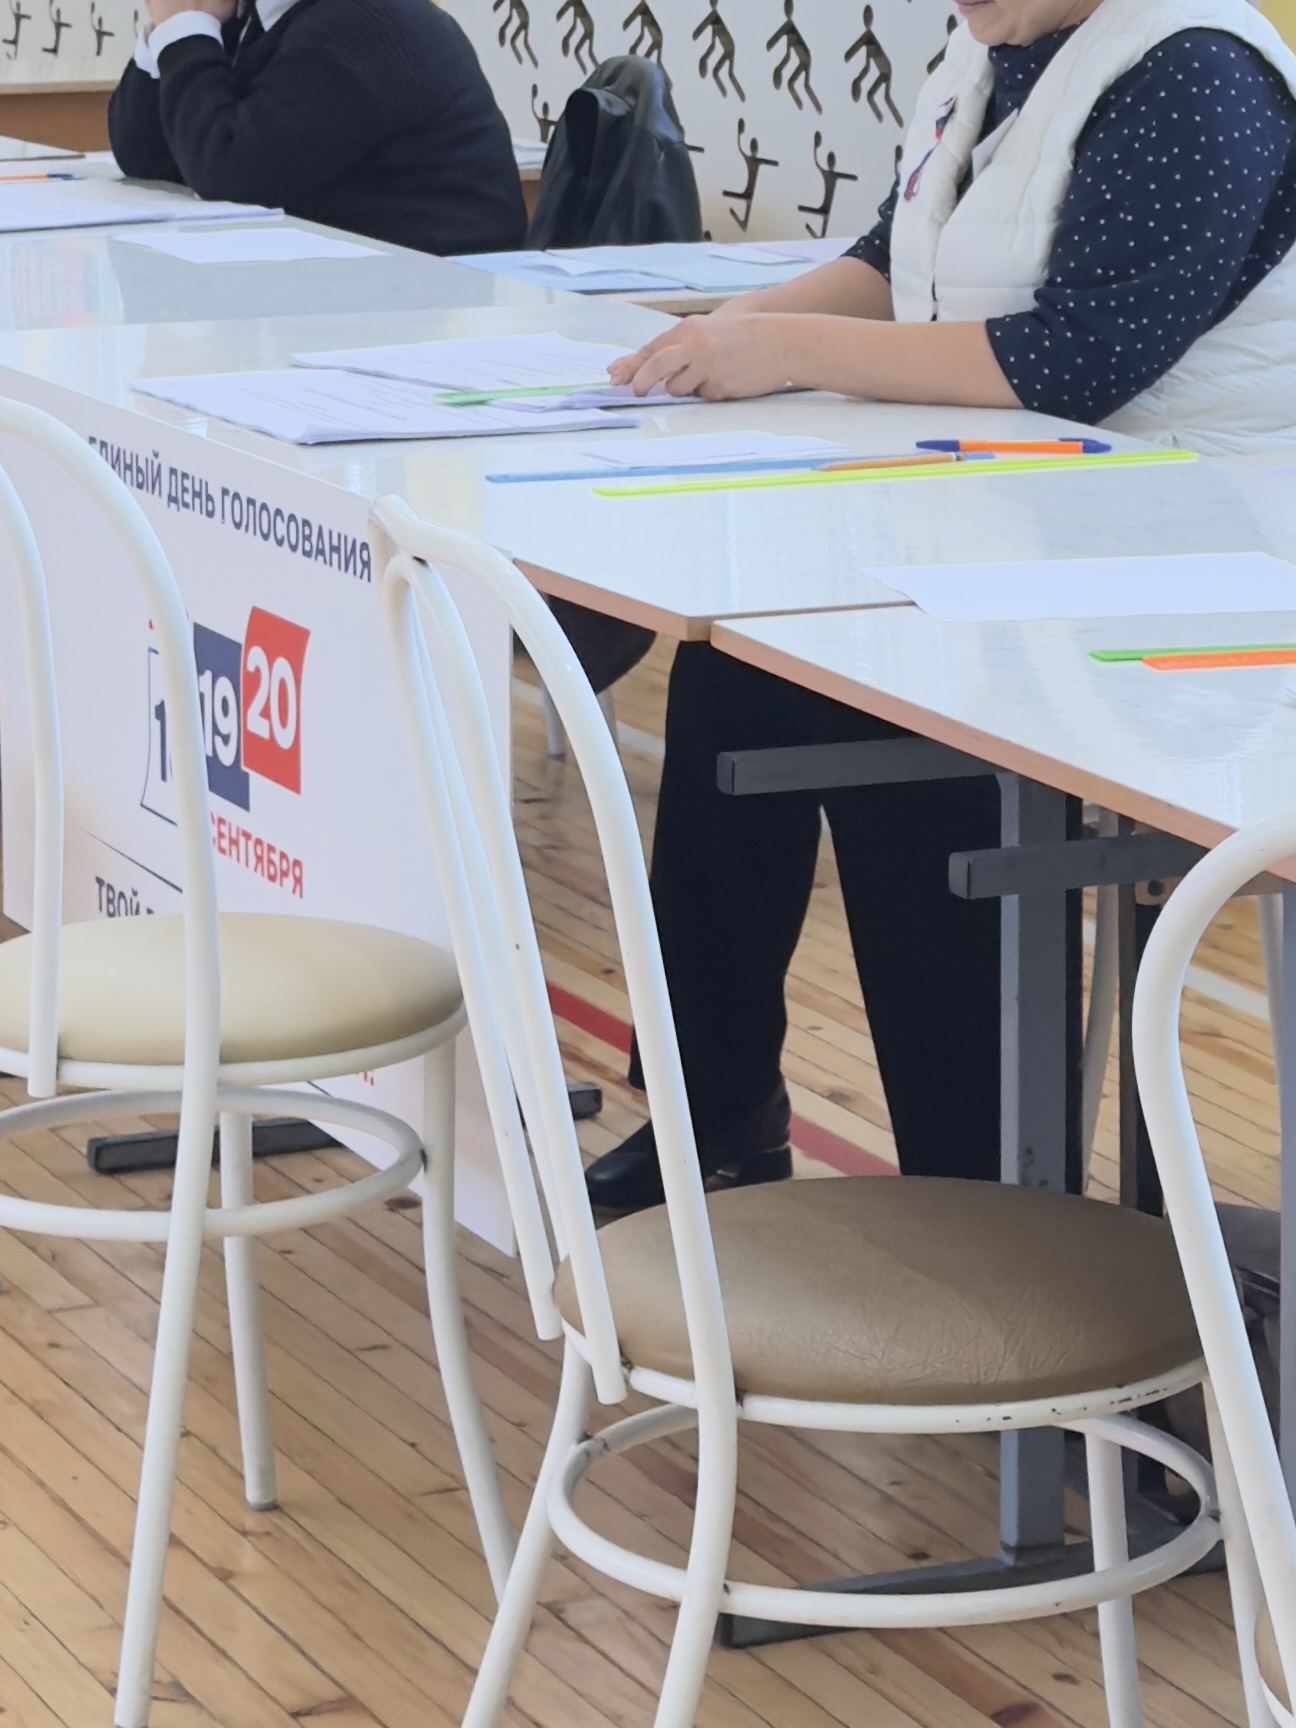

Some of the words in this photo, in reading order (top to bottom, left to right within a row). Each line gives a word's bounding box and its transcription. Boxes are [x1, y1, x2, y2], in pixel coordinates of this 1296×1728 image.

[166, 466, 216, 519] ДЕНЬ
[220, 486, 371, 583] ГОЛОСОВАНИЯ
[155, 698, 173, 783] 1
[198, 669, 238, 767] 19
[245, 645, 297, 751] 20
[210, 811, 303, 899] ЕНТЯБРЯ
